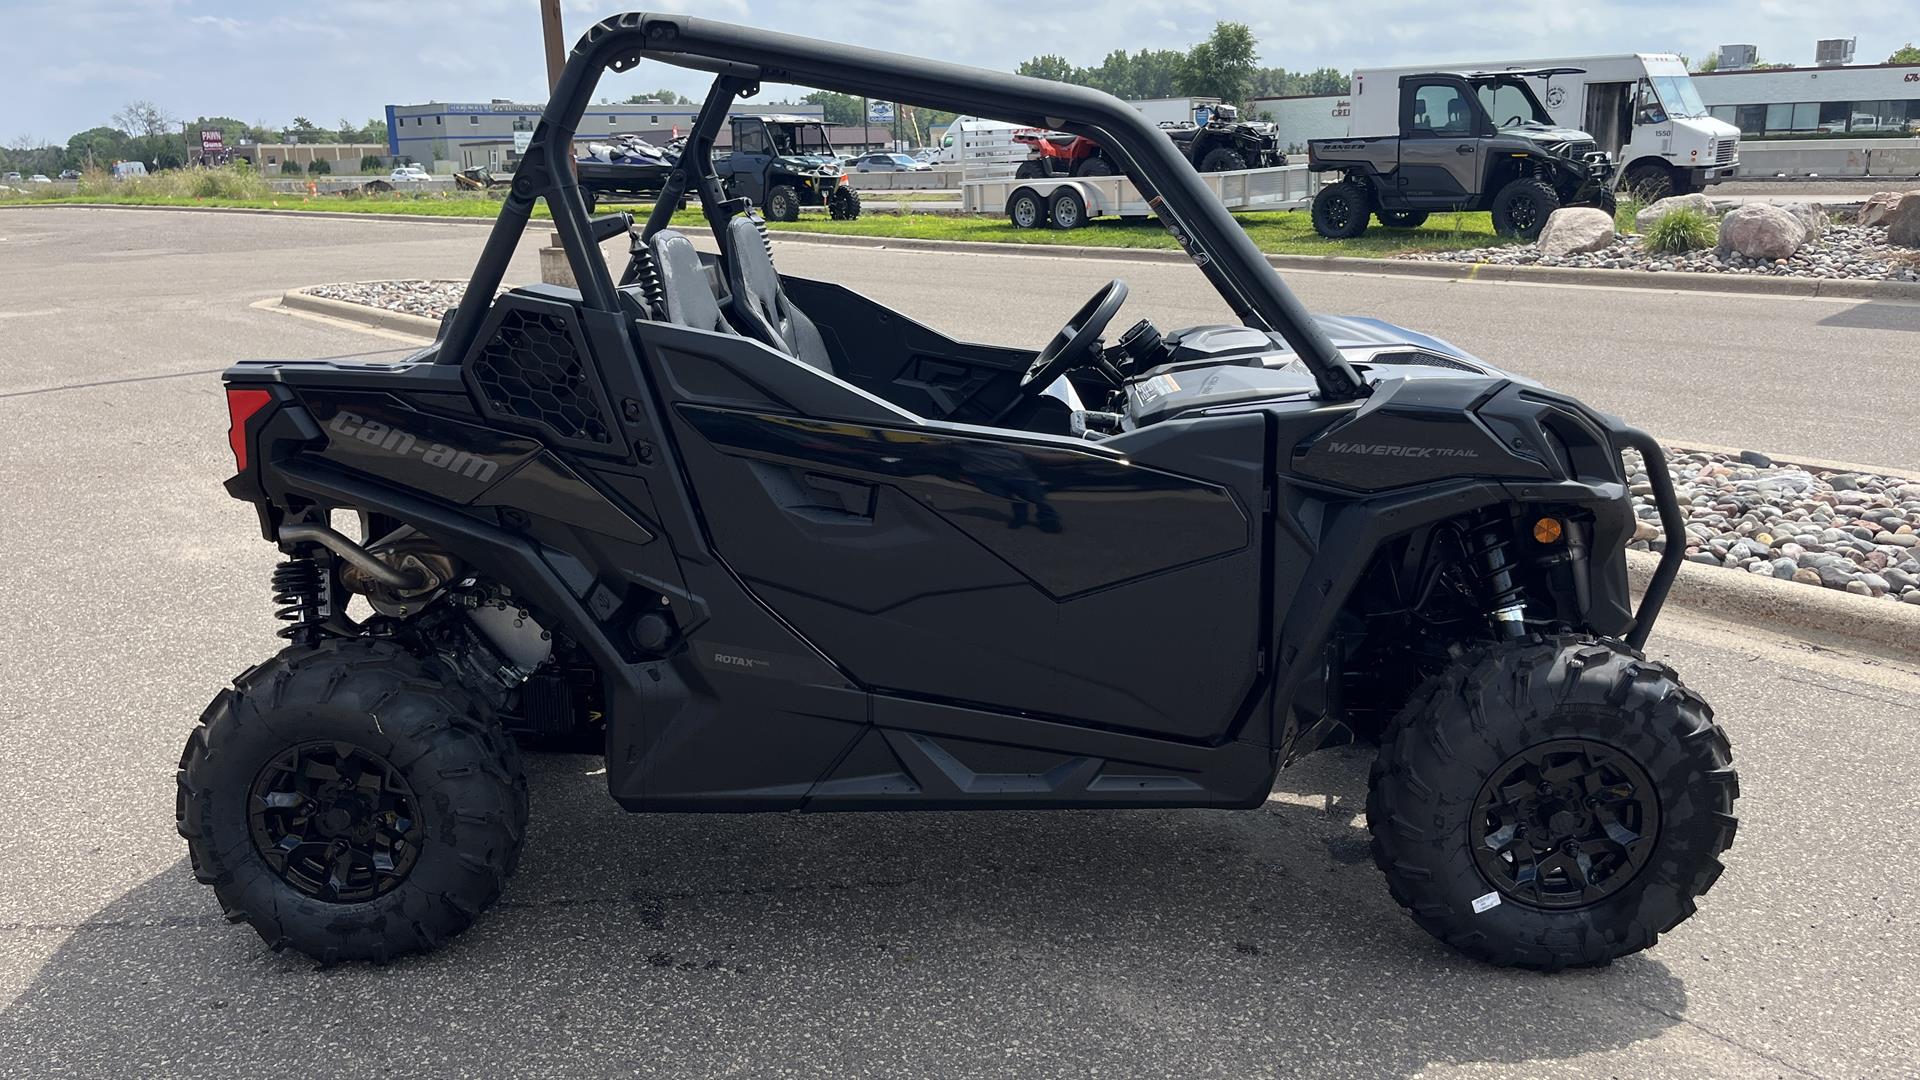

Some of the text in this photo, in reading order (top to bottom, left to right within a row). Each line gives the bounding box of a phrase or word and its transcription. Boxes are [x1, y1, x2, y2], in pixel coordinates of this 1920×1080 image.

[202, 131, 221, 141] PAWN
[329, 410, 499, 483] can-am
[1328, 442, 1479, 458] MAVERICK TRAIL
[714, 653, 754, 667] ROTAX
